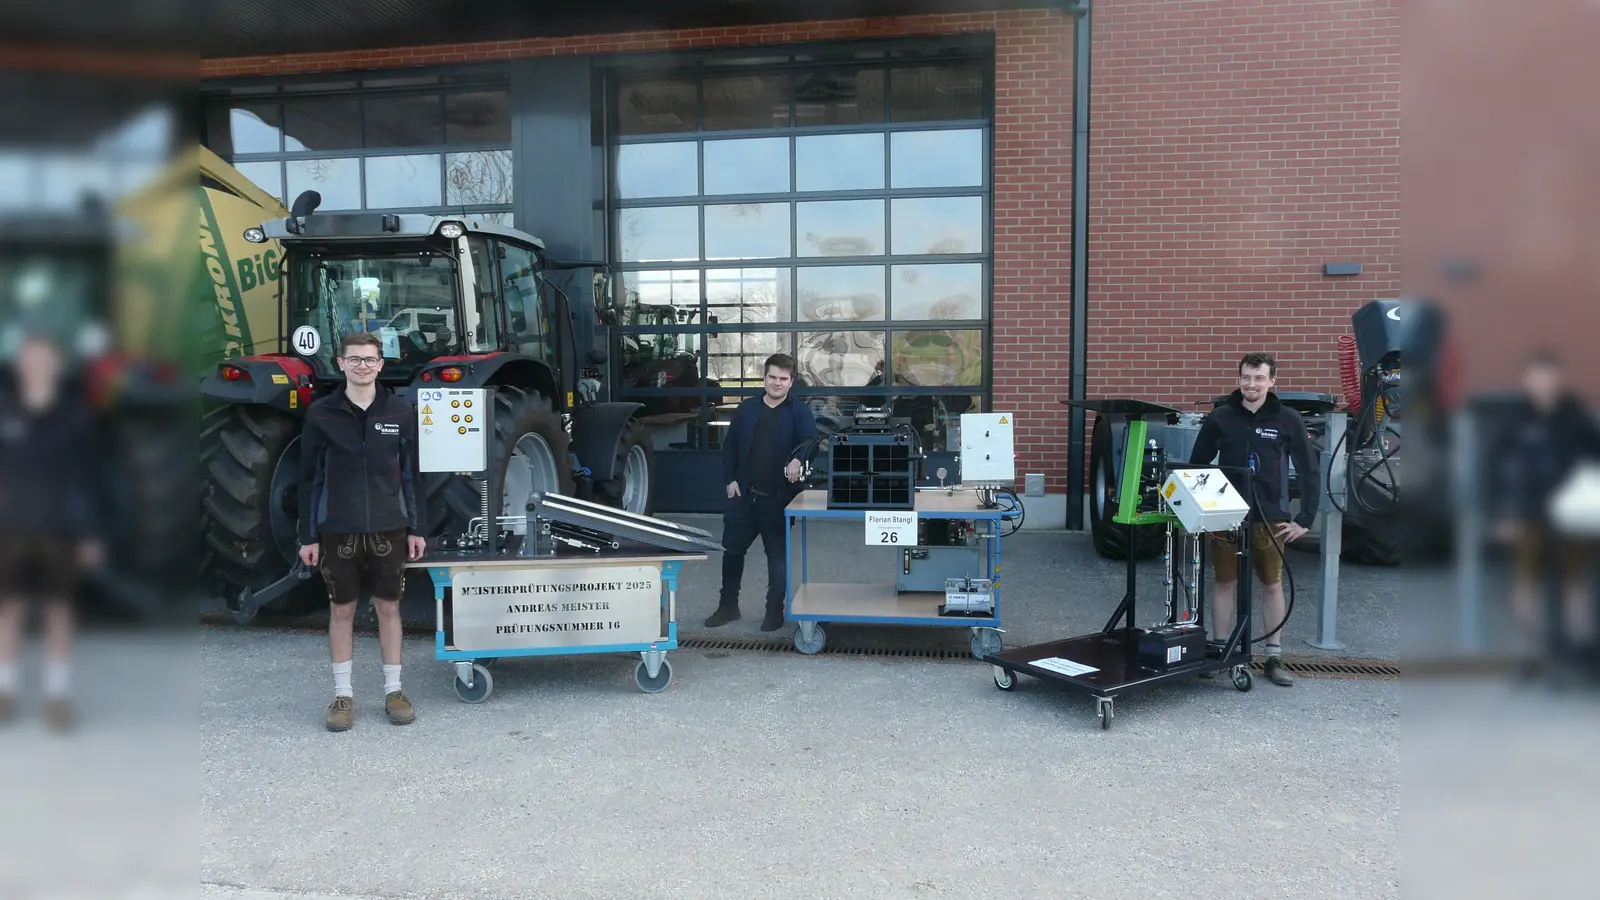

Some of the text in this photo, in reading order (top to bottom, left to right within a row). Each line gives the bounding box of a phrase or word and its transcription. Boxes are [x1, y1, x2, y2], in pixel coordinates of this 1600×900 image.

[236, 249, 280, 293] BiG
[299, 331, 315, 350] 40
[892, 516, 913, 524] Stangl
[880, 531, 898, 543] 26
[461, 581, 652, 596] MEISTERPRÜFUNGSPROJEKT 2025
[506, 601, 610, 613] ANDREAS MEISTER
[496, 621, 621, 634] PRÜFUNGSNUMMER 16
